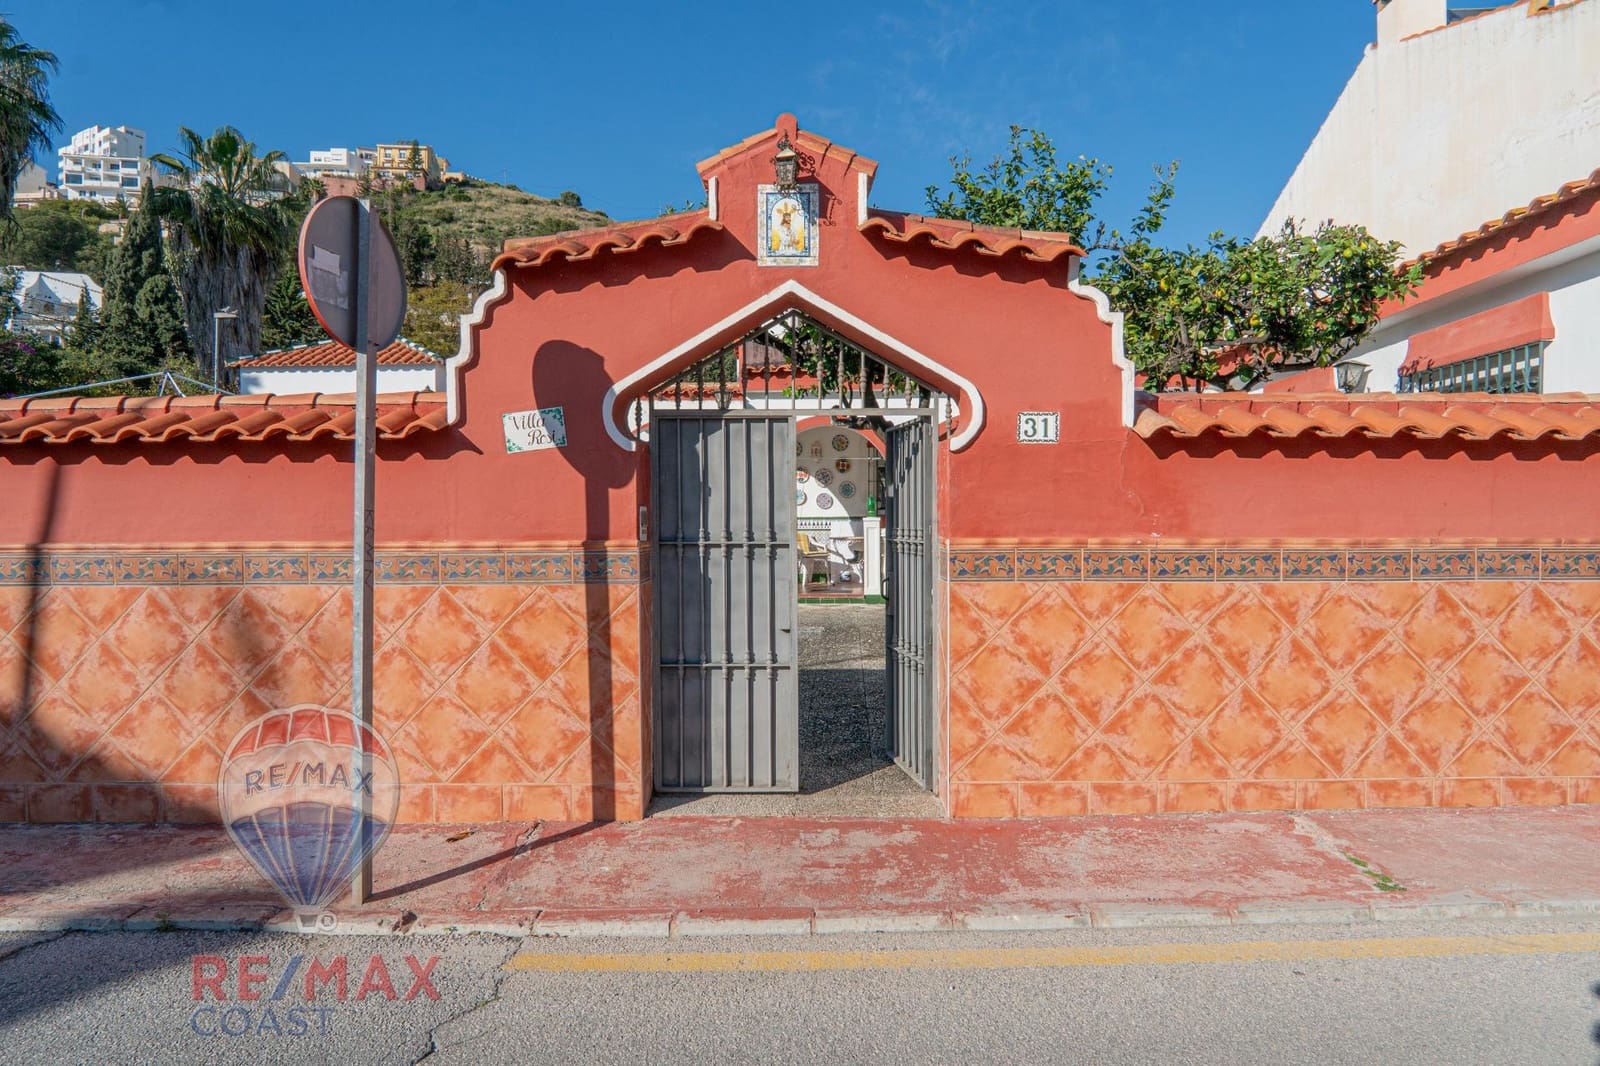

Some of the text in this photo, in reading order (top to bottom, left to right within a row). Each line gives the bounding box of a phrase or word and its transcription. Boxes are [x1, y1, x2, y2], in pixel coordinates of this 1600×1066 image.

[509, 412, 546, 430] Villa
[1024, 417, 1049, 438] 31
[528, 429, 557, 446] Rosi
